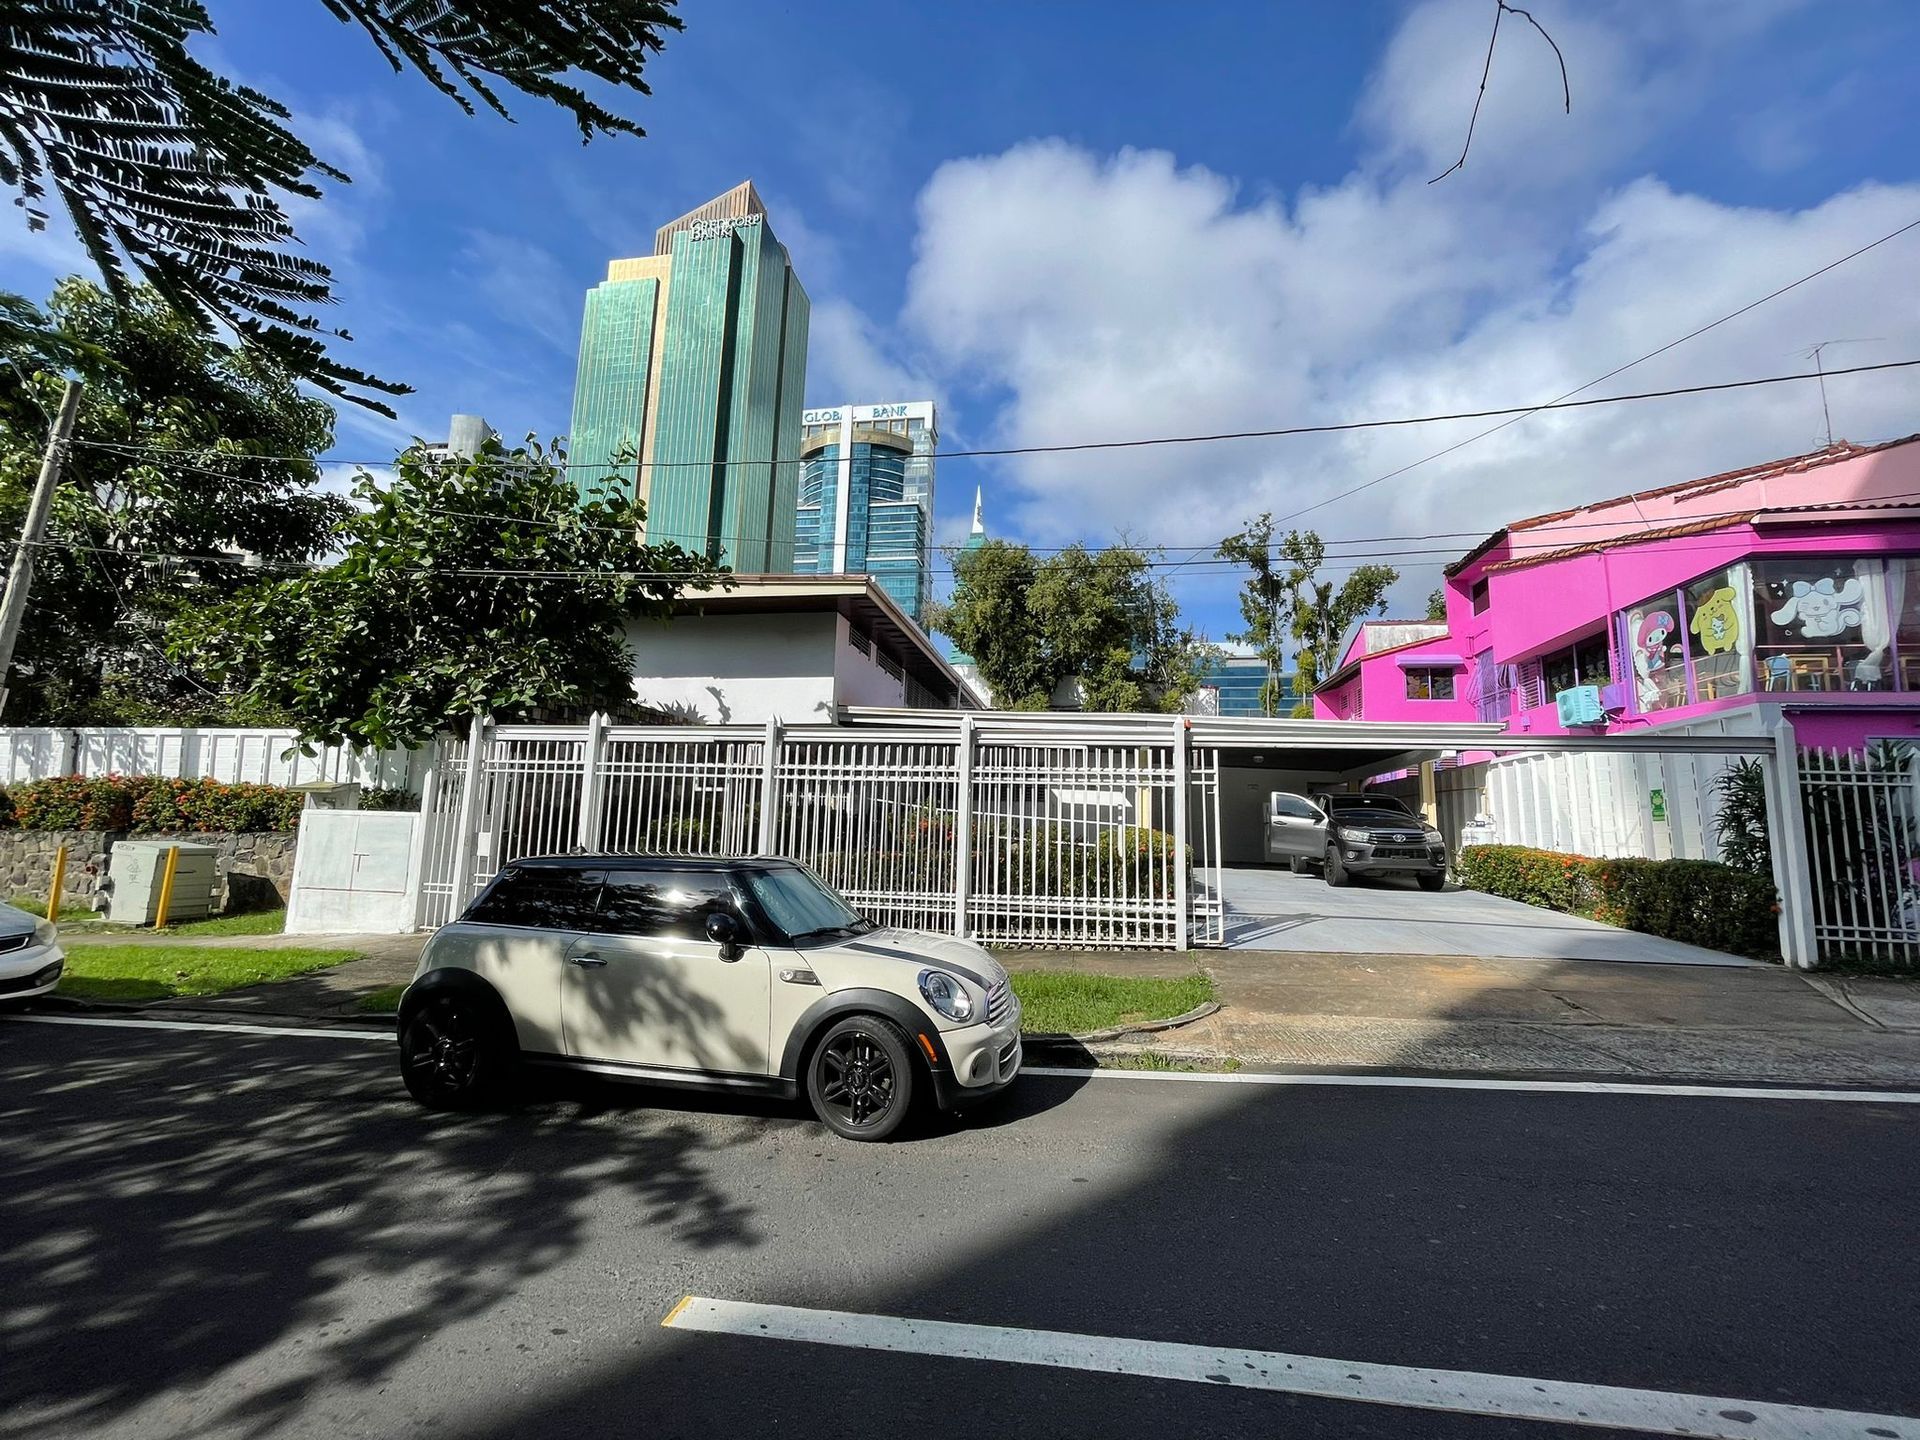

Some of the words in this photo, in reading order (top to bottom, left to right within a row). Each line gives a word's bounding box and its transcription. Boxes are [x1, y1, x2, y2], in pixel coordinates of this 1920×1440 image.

[691, 226, 732, 241] BANK
[805, 410, 857, 422] GLOB
[872, 405, 908, 418] BANK
